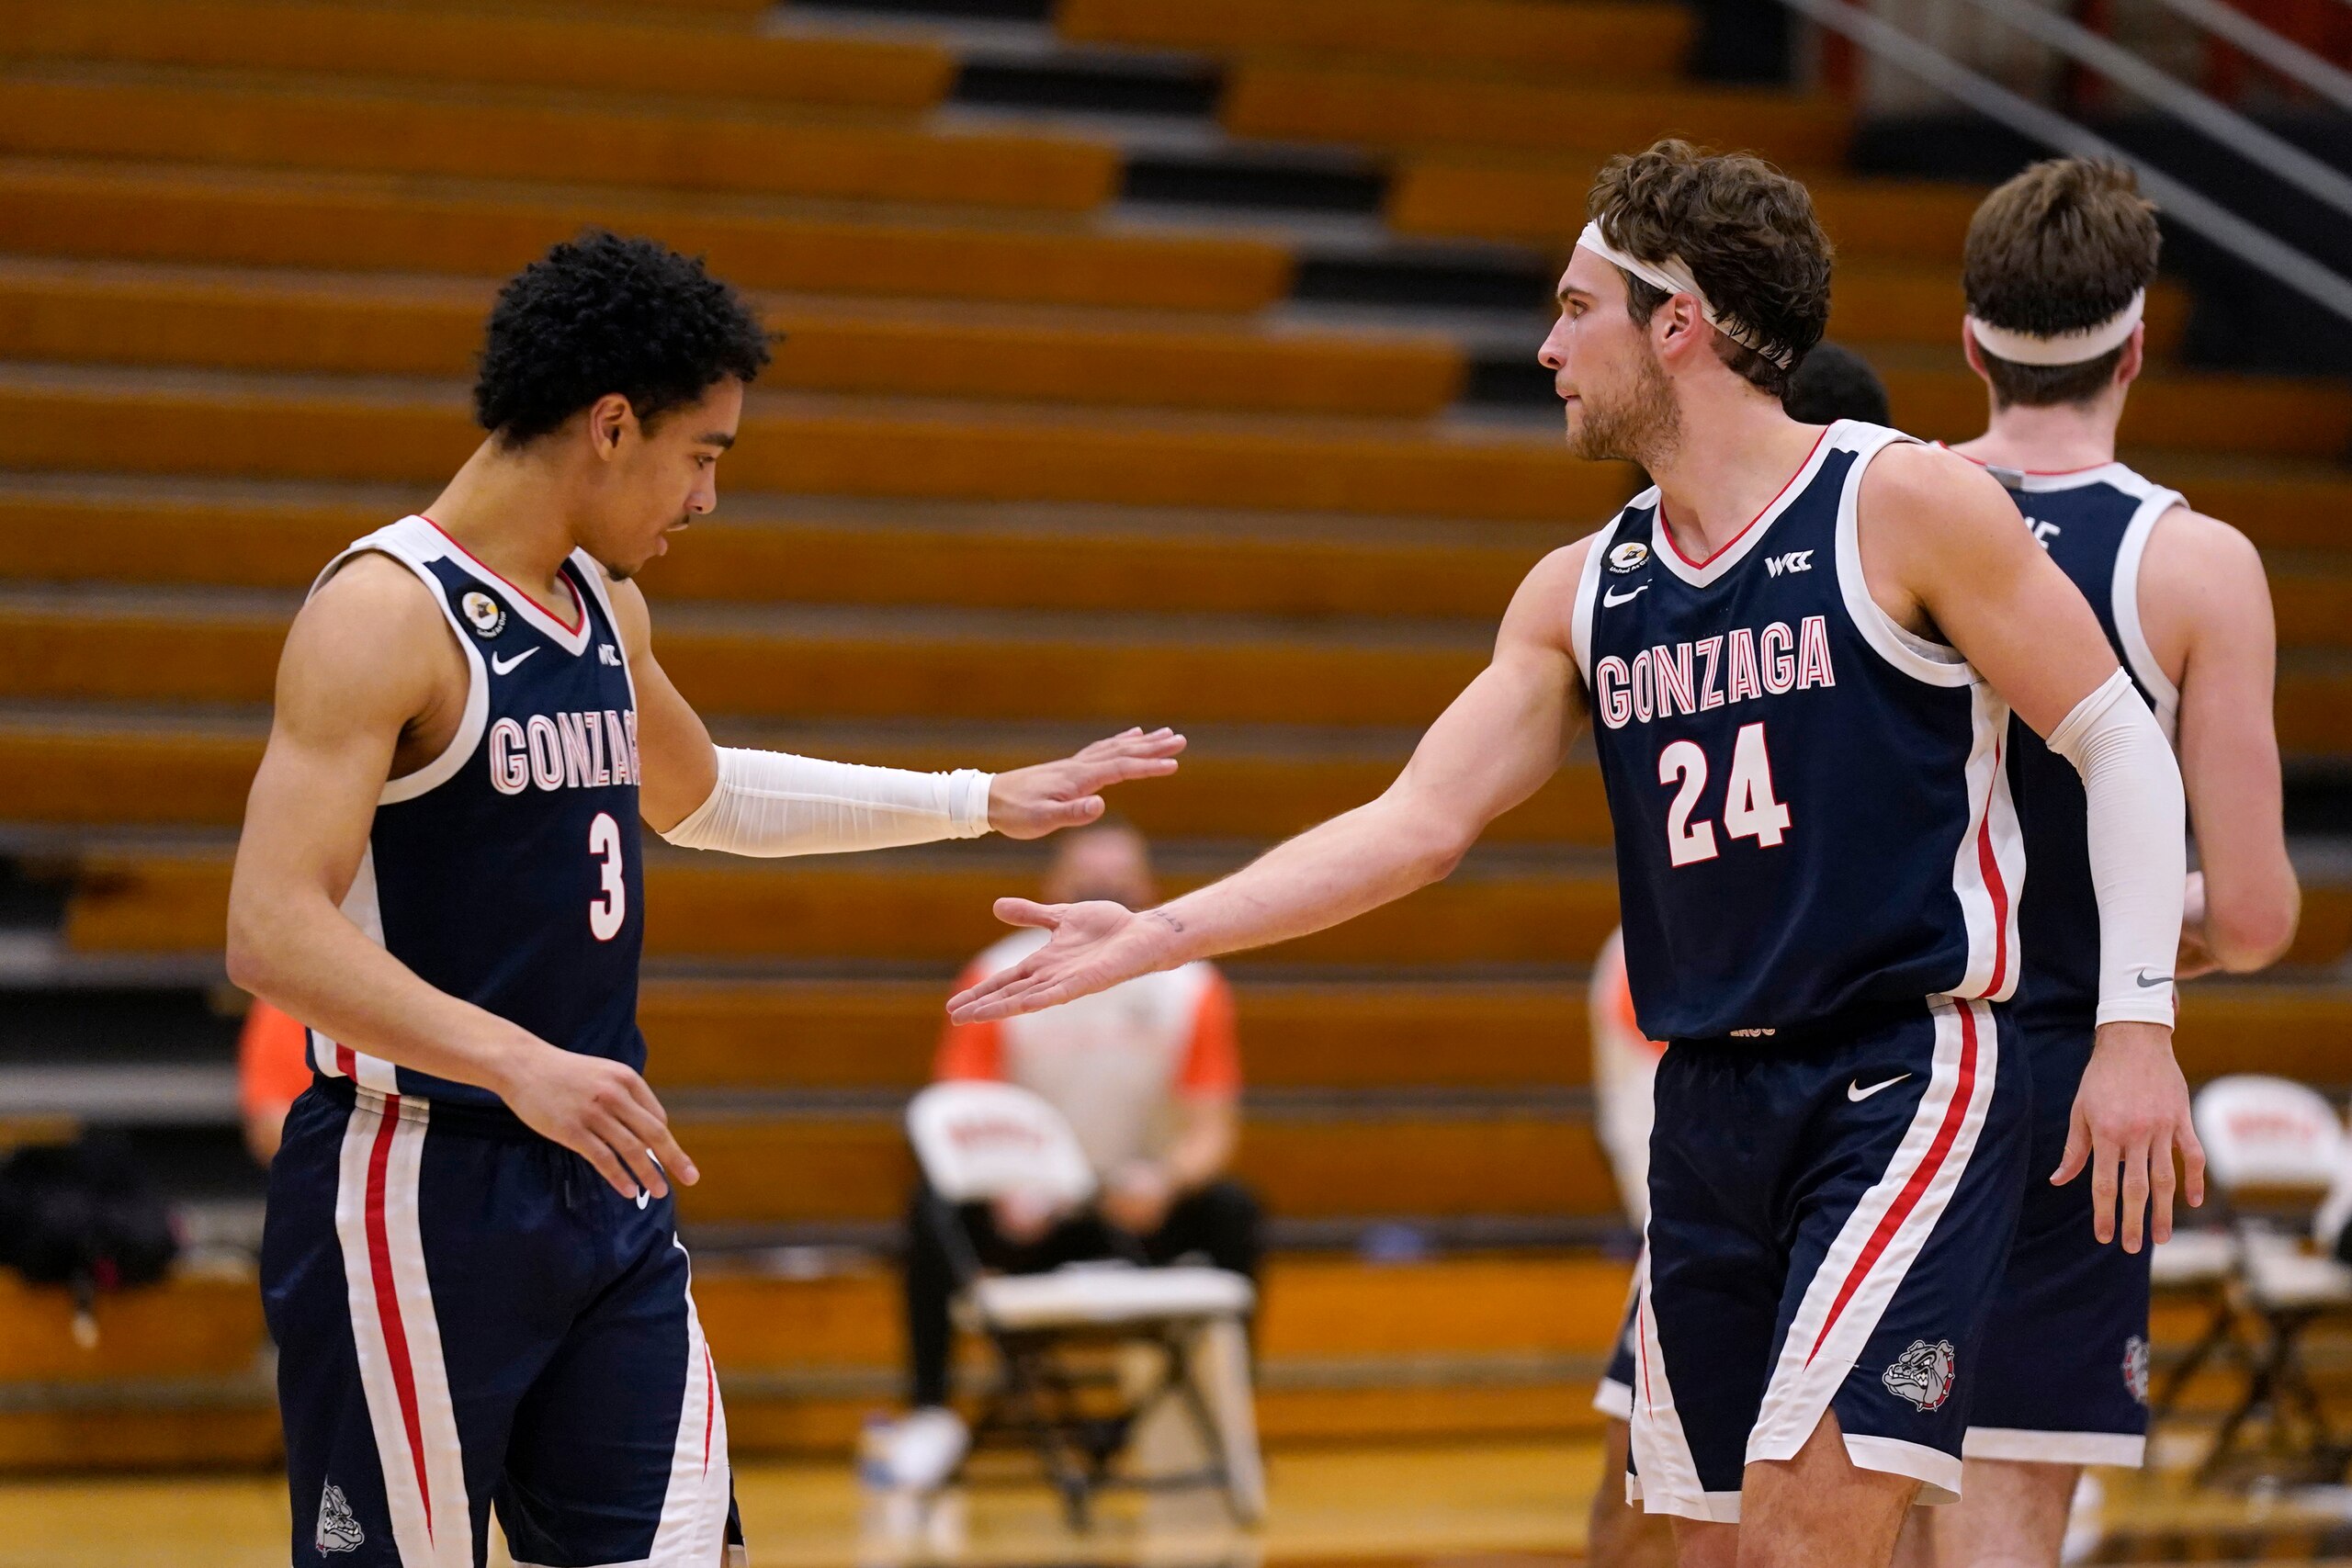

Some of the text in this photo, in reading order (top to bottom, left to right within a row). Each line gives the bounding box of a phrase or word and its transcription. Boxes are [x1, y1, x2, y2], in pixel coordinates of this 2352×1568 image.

[1609, 566, 1631, 574] United
[1765, 549, 1815, 579] WCC
[1597, 615, 1837, 729] GONZAGA
[1658, 720, 1792, 868] 24
[589, 812, 626, 941] 3
